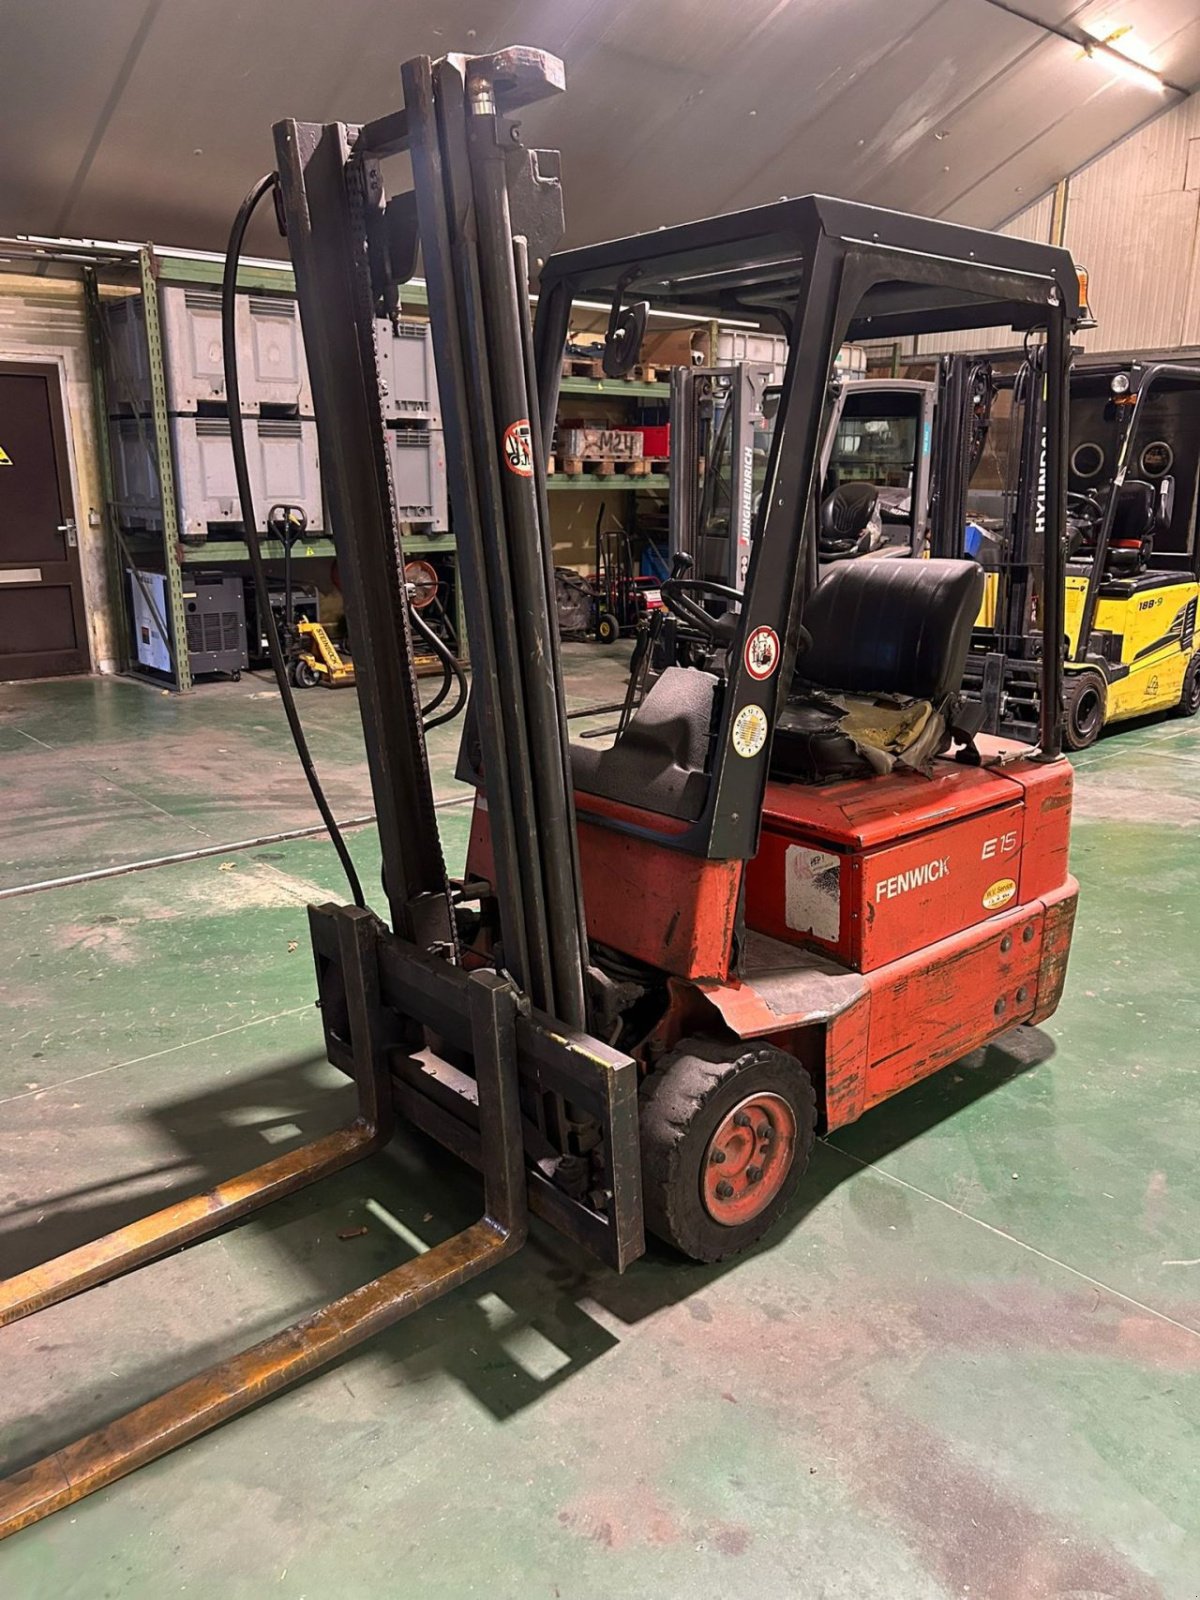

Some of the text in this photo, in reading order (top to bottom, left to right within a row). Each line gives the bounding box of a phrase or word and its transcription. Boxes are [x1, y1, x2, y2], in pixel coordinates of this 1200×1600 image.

[600, 431, 634, 457] M24
[739, 446, 753, 546] JUNGHEINRICH
[876, 855, 950, 904] FENWICK
